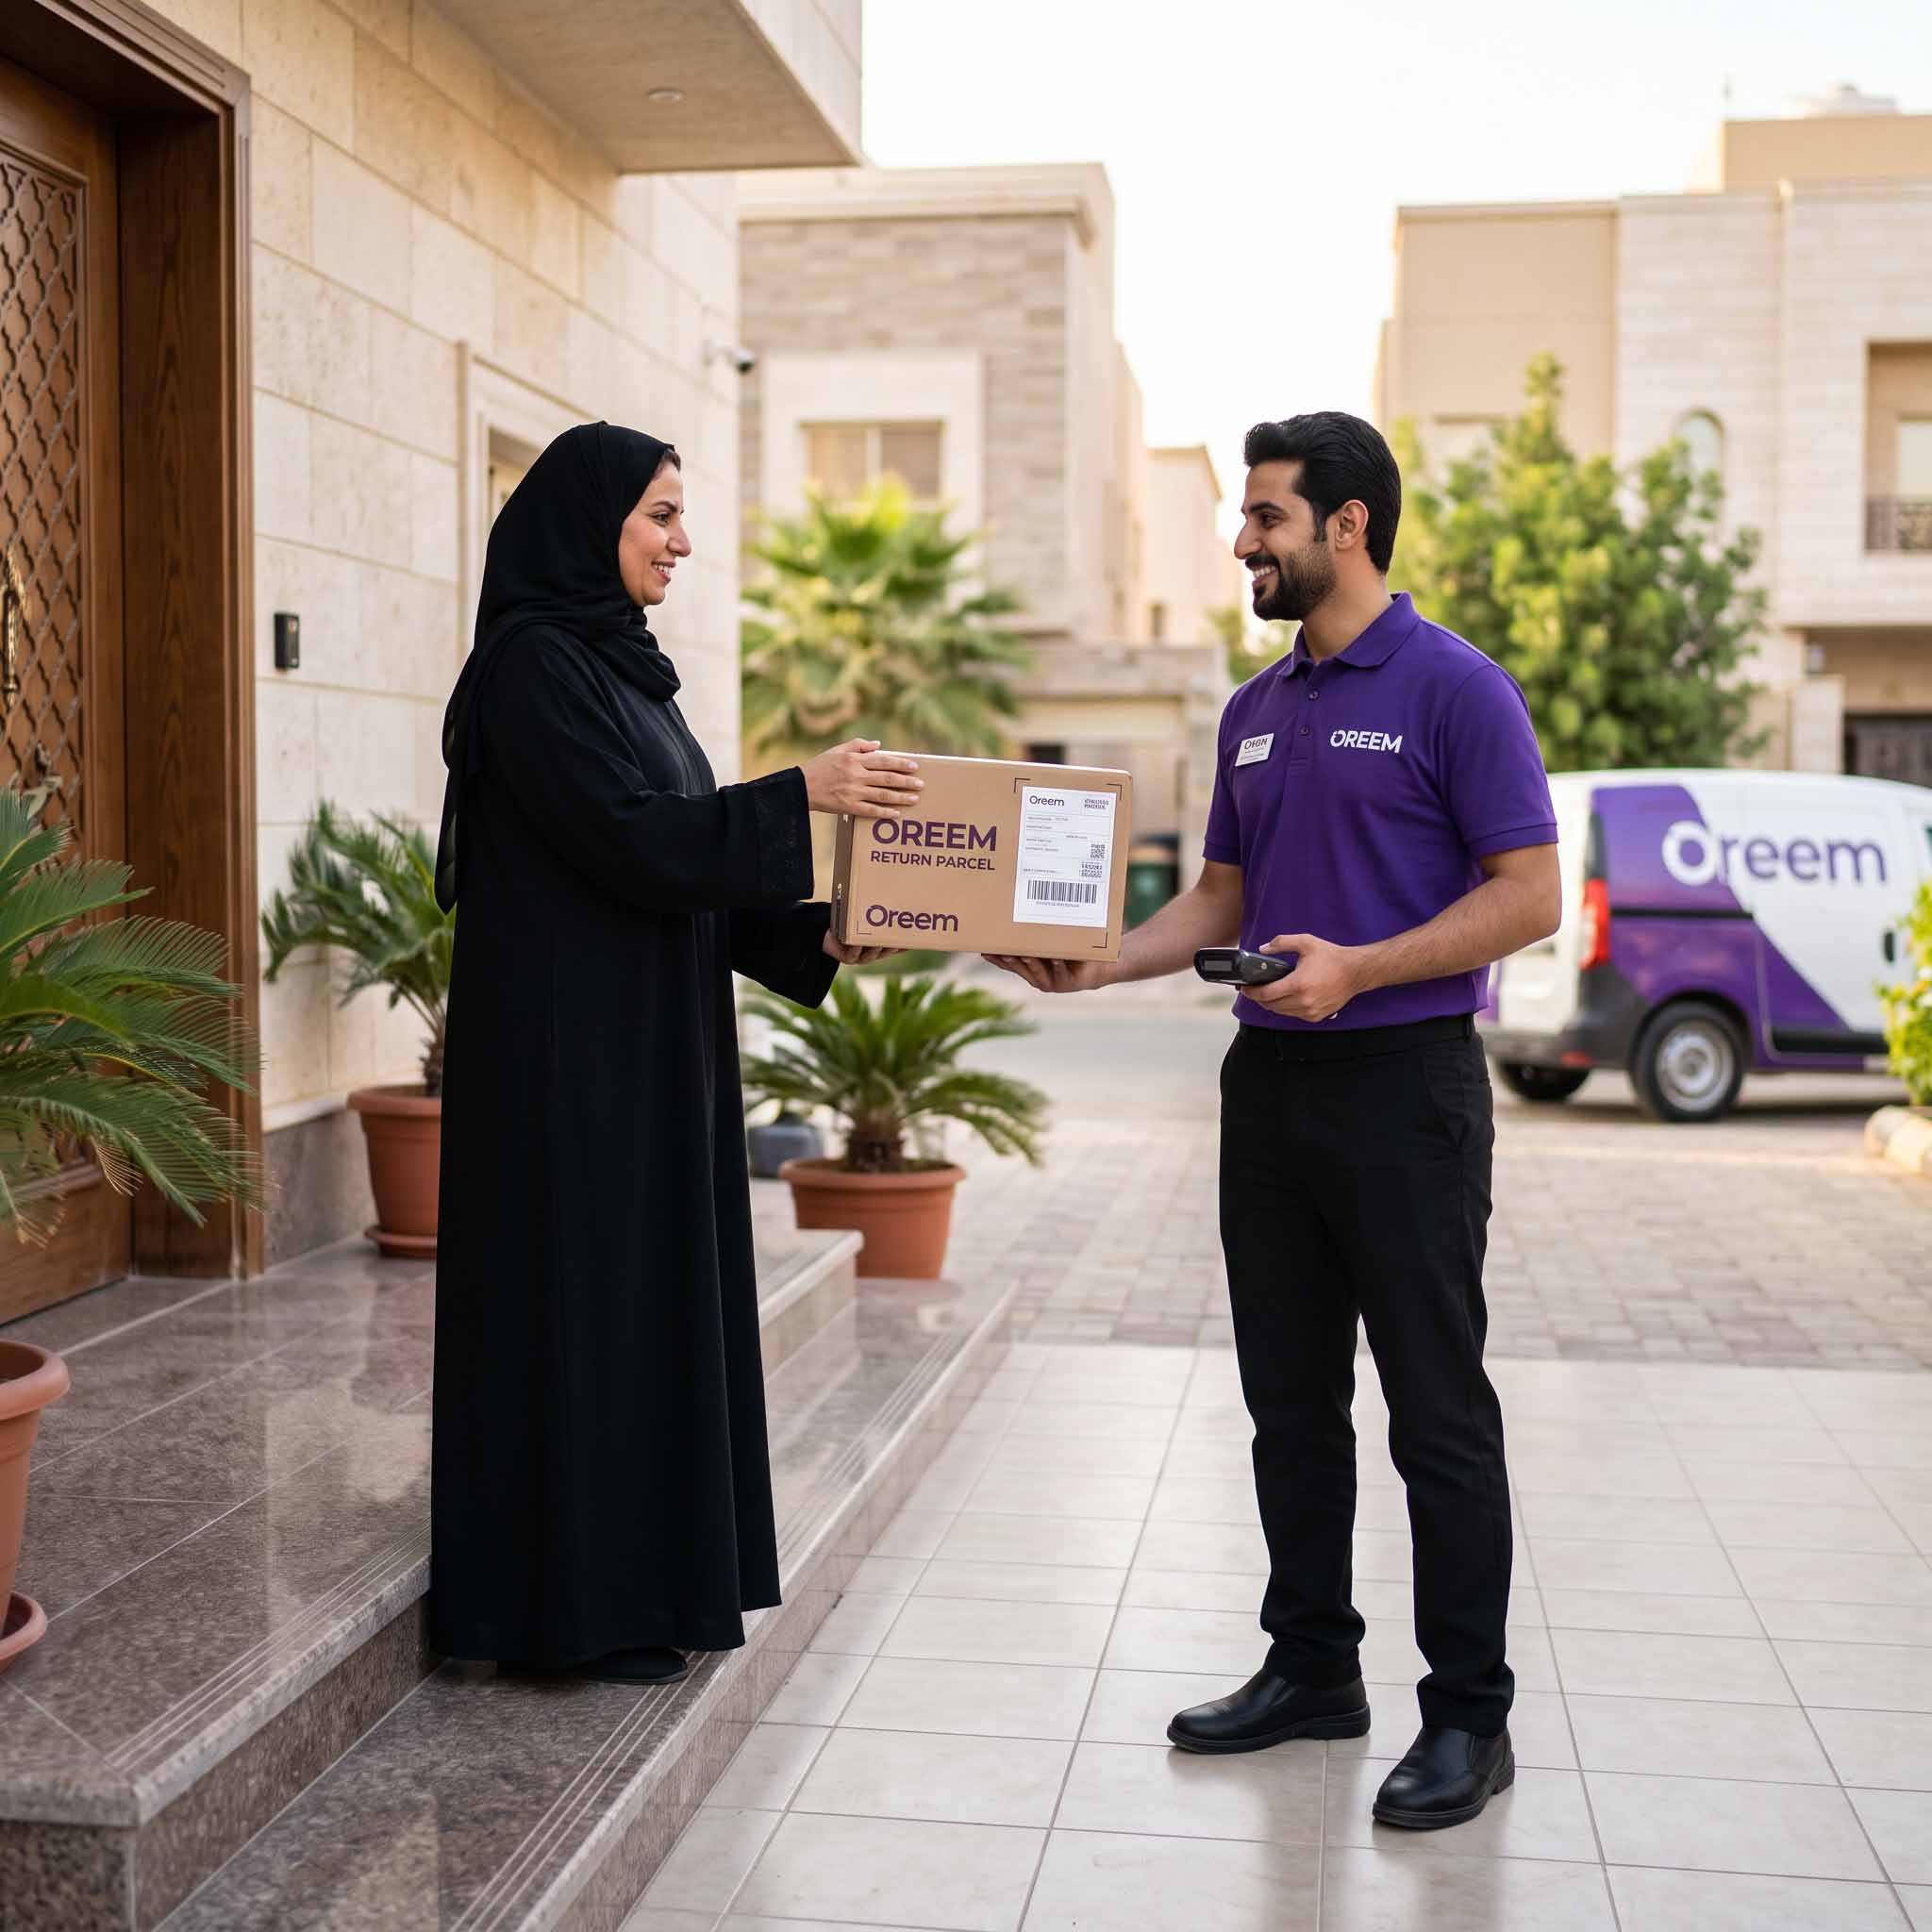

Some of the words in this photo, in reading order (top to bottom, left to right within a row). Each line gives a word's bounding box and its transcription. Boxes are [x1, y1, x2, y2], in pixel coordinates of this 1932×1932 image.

[1330, 729, 1403, 754] OREEM
[1029, 795, 1065, 807] Oreem
[872, 818, 997, 852] OREEM
[870, 851, 932, 866] RETURN
[936, 856, 996, 871] PARCEL
[1661, 820, 1888, 887] Oreem
[866, 905, 958, 932] Oreem
